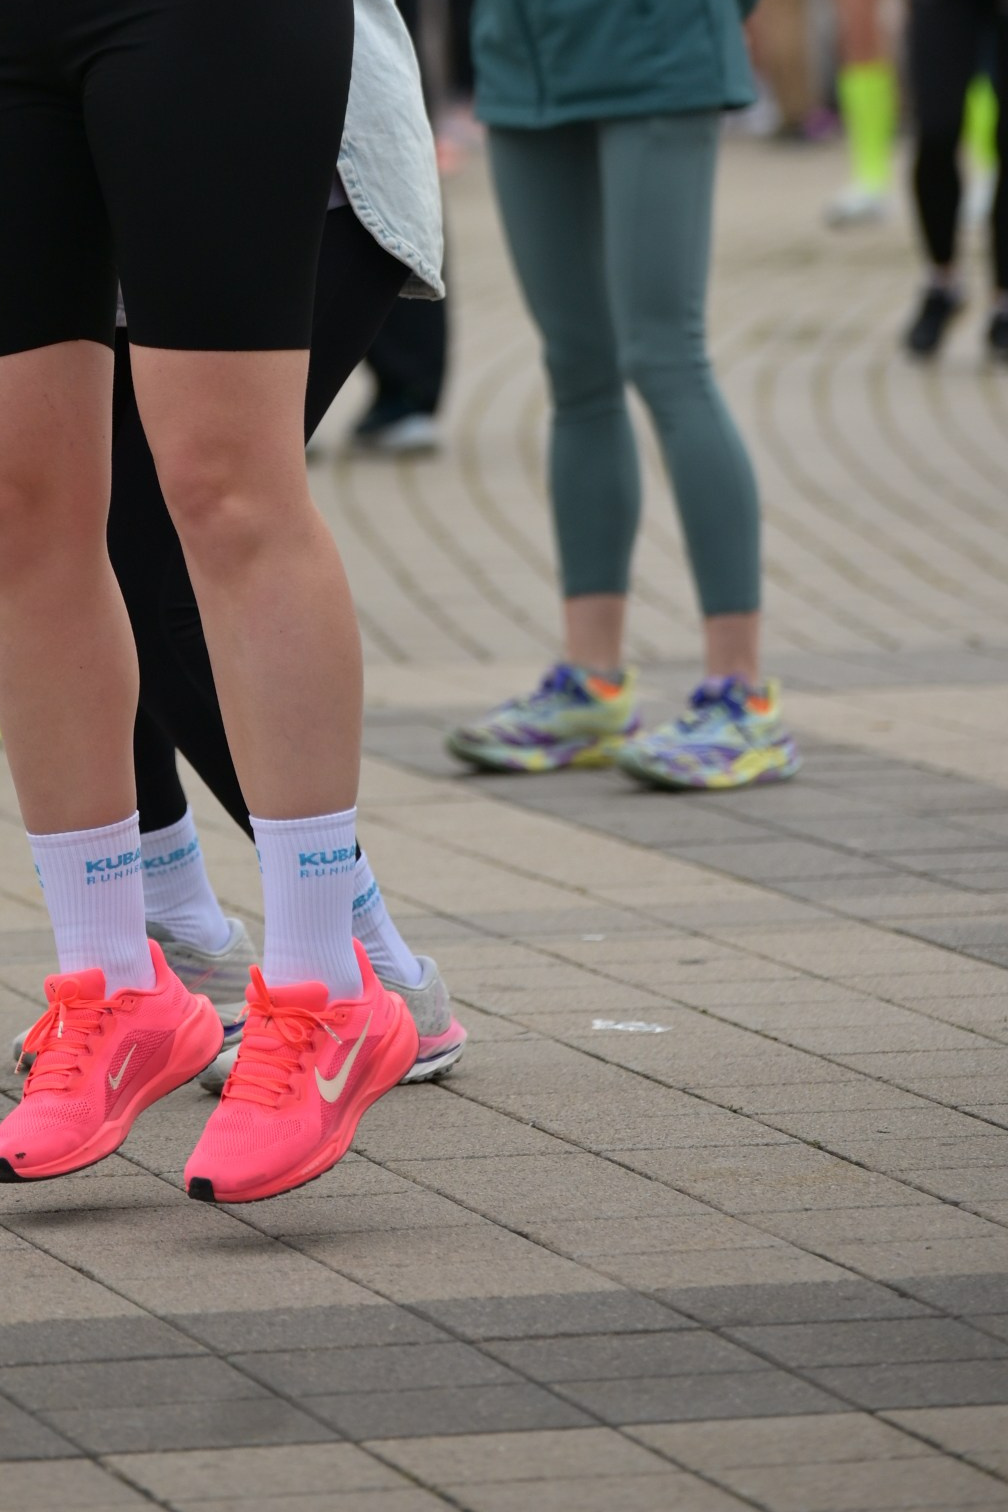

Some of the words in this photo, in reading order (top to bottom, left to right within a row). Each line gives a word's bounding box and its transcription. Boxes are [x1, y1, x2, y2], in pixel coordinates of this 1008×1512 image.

[86, 848, 140, 874] KUBA
[142, 842, 198, 870] KUBA
[298, 845, 356, 867] KUBA
[86, 863, 141, 886] RUNNE
